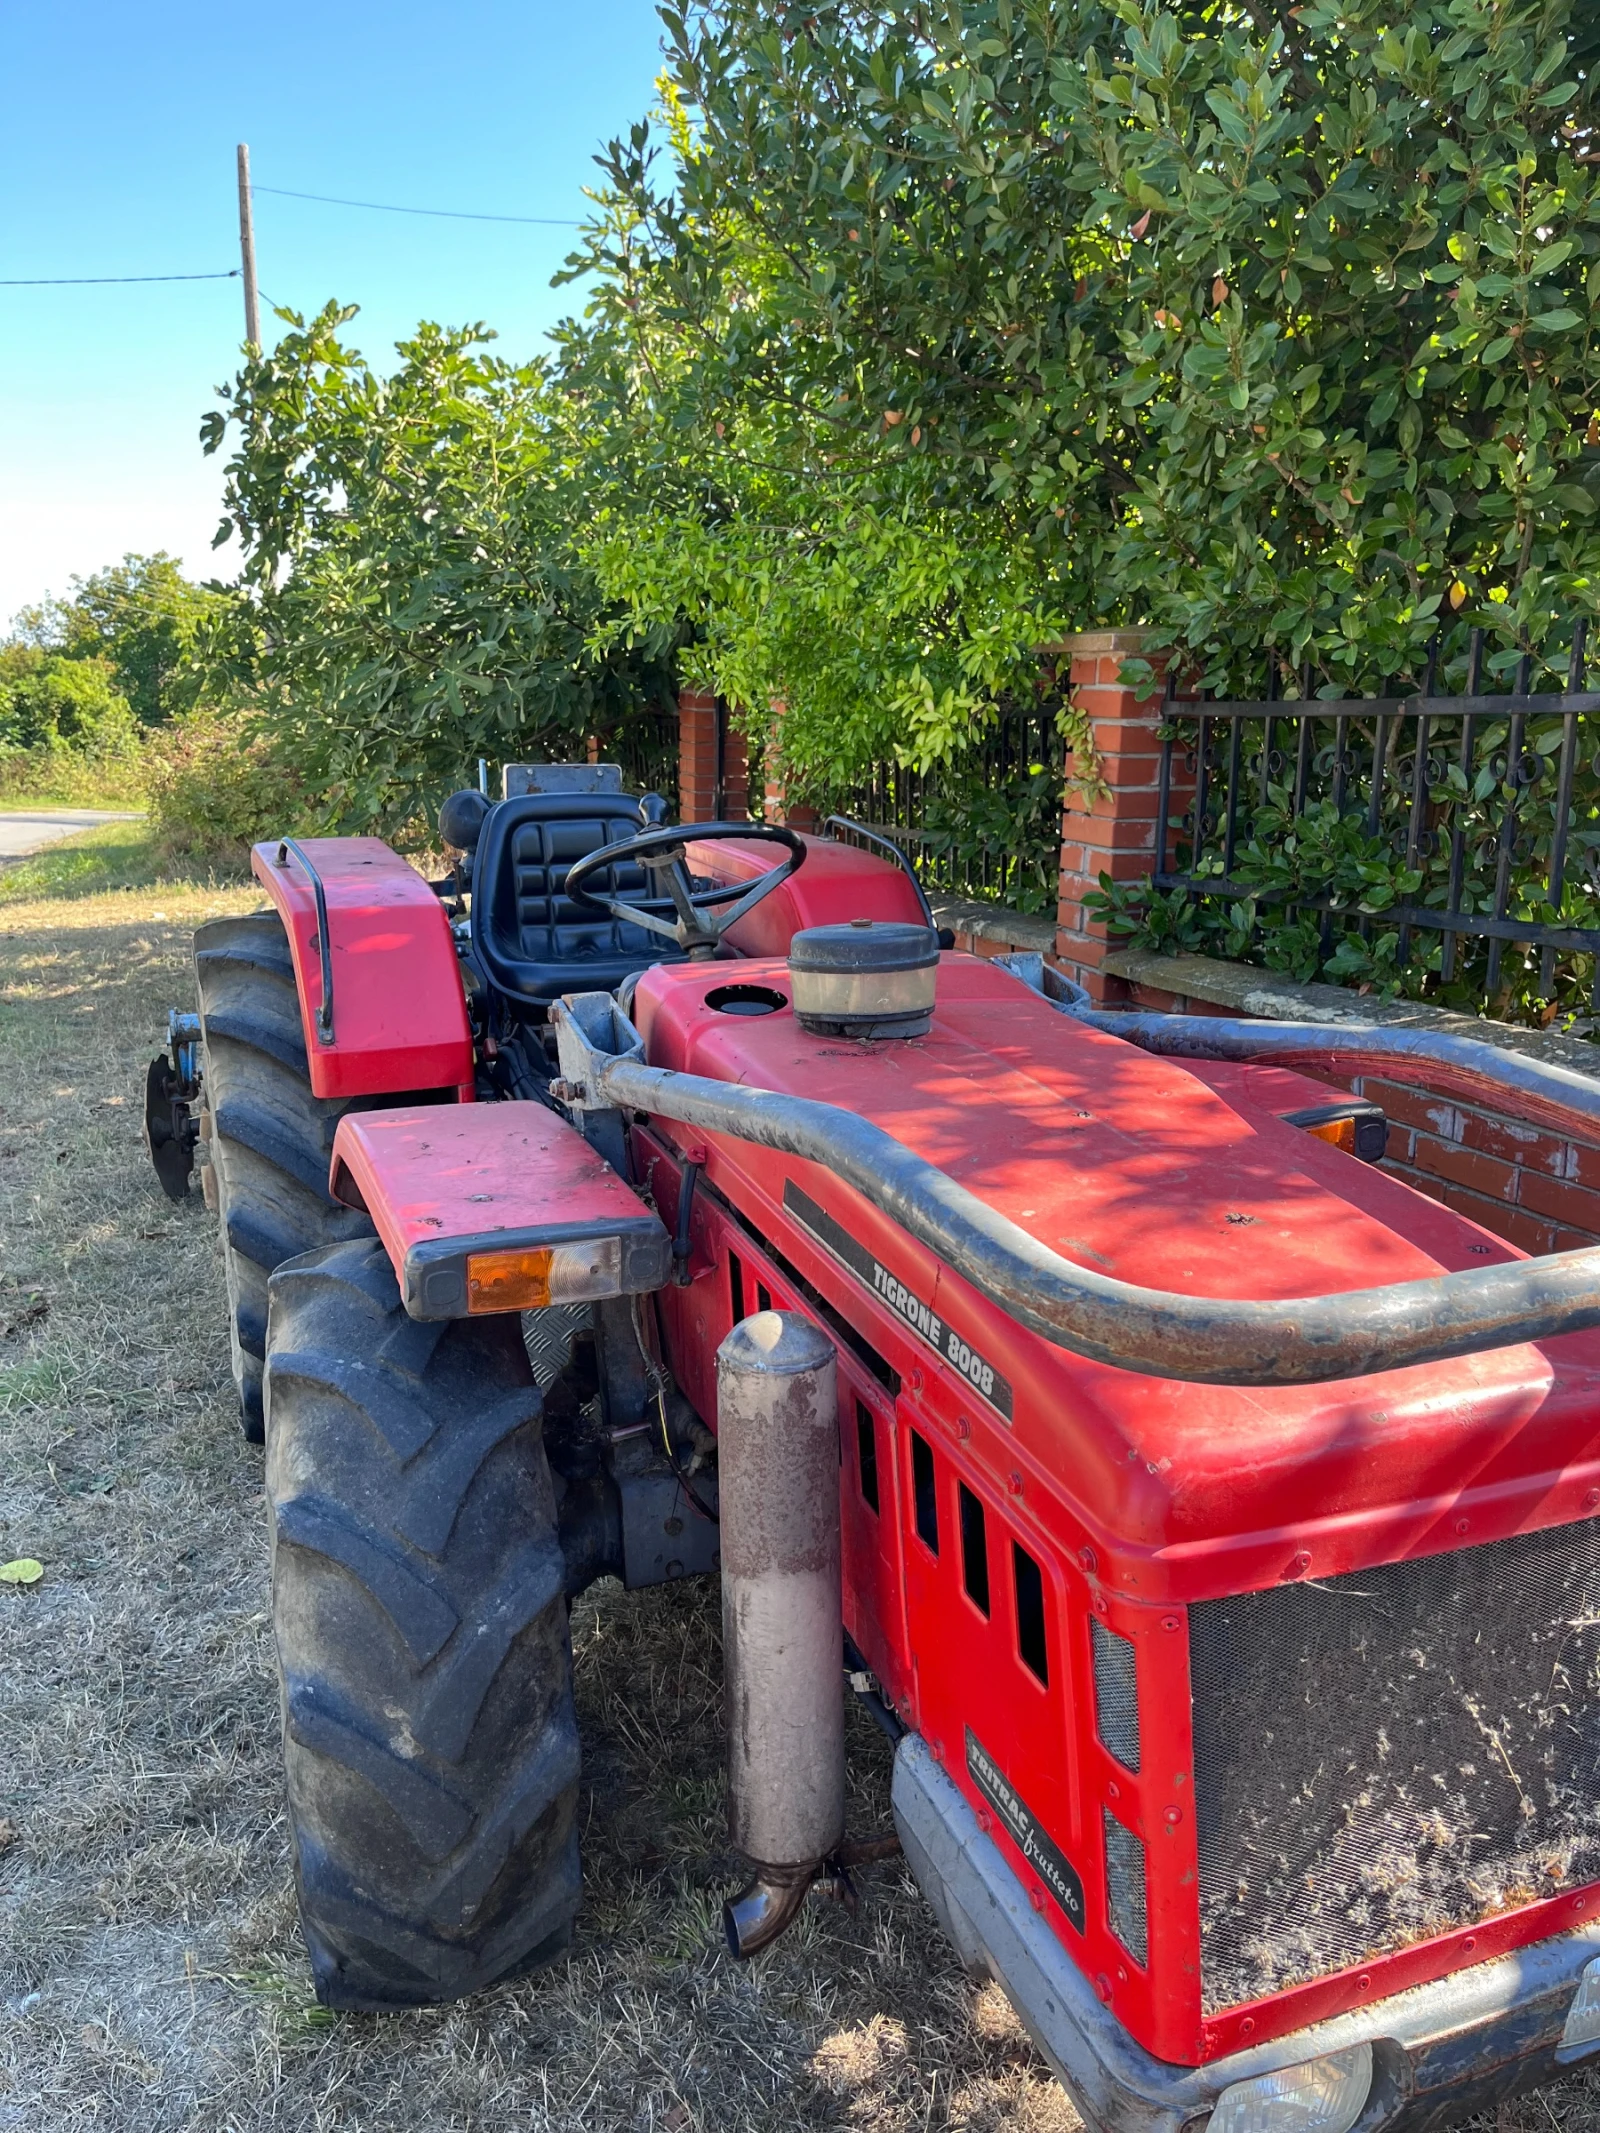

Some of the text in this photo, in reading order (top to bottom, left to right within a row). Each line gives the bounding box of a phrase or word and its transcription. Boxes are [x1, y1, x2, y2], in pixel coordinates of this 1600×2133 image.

[872, 1262, 994, 1396] TIGRONE 8008
[972, 1744, 1079, 1912] TRITRAC frutteto
